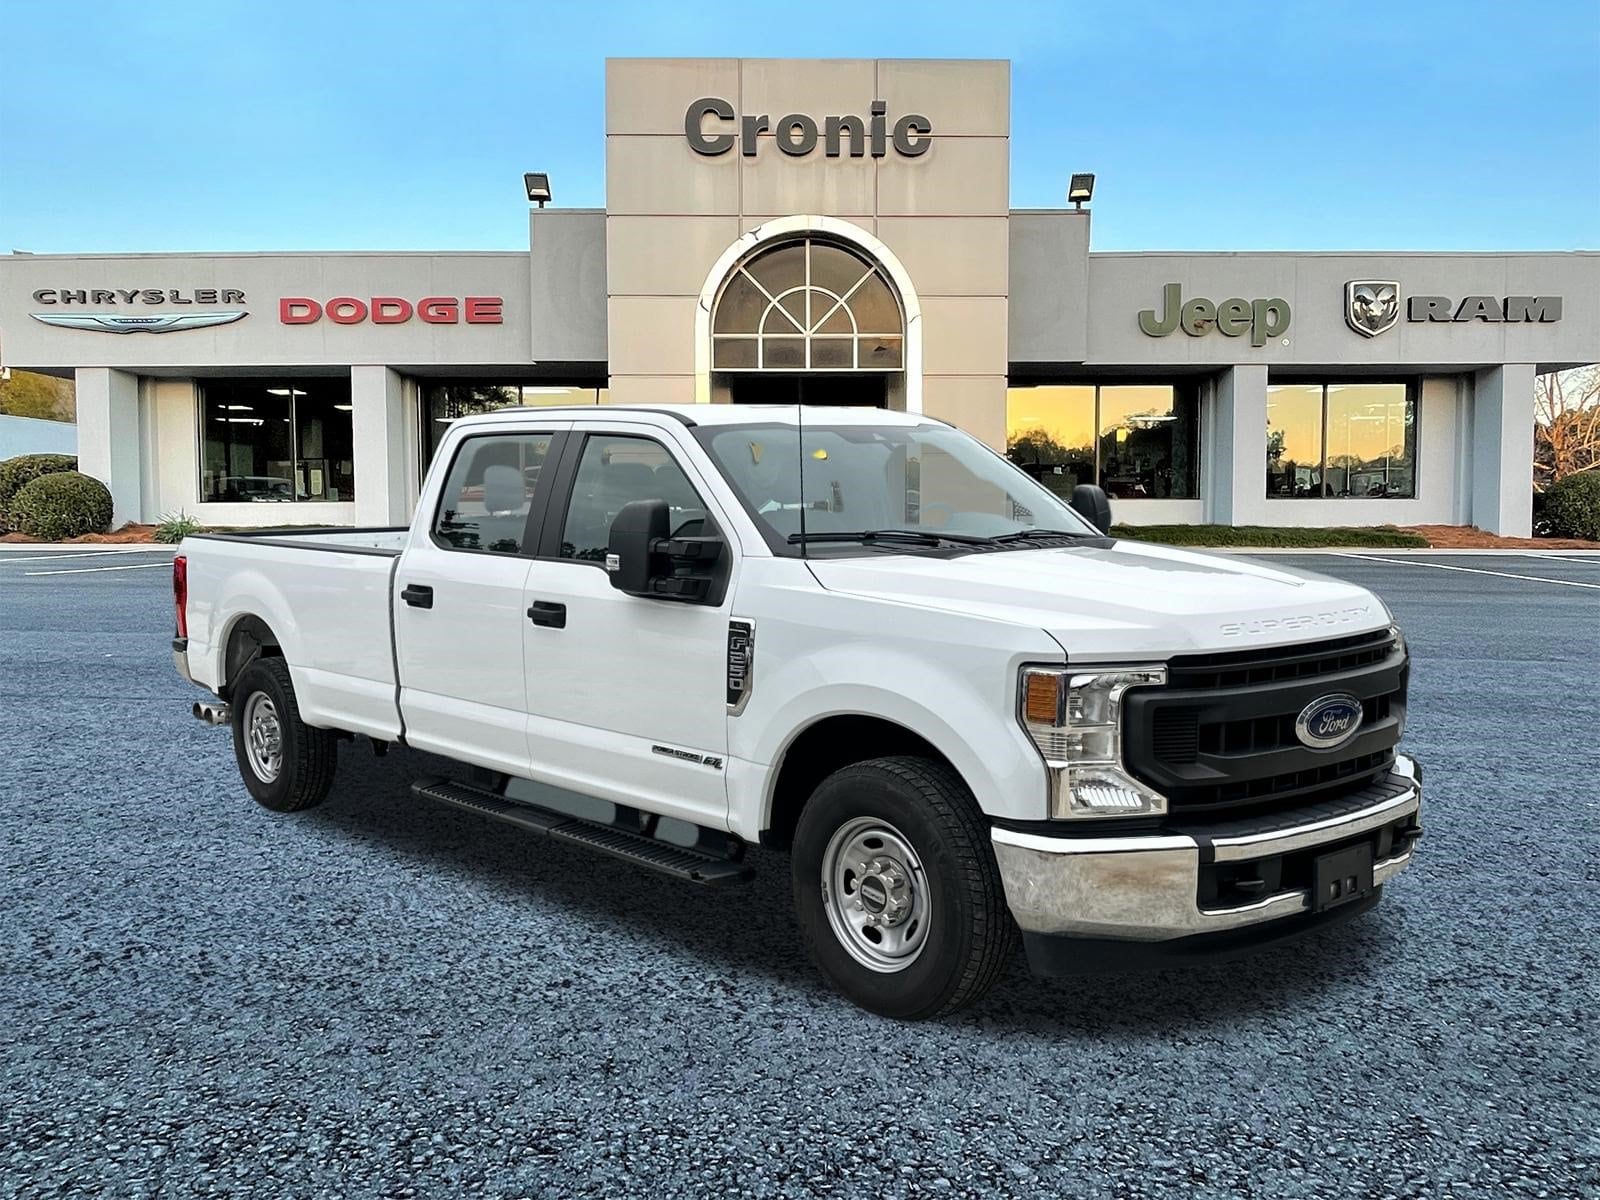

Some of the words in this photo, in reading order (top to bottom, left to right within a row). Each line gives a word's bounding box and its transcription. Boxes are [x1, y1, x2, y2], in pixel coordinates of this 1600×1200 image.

[684, 97, 932, 158] Cronic
[32, 288, 247, 305] CHRYSLER
[279, 296, 504, 325] DODGE
[1406, 296, 1563, 323] RAM
[1137, 282, 1291, 348] Jeep
[1219, 615, 1319, 638] SUPER
[1317, 606, 1370, 625] DUTY
[1318, 709, 1351, 735] Ford
